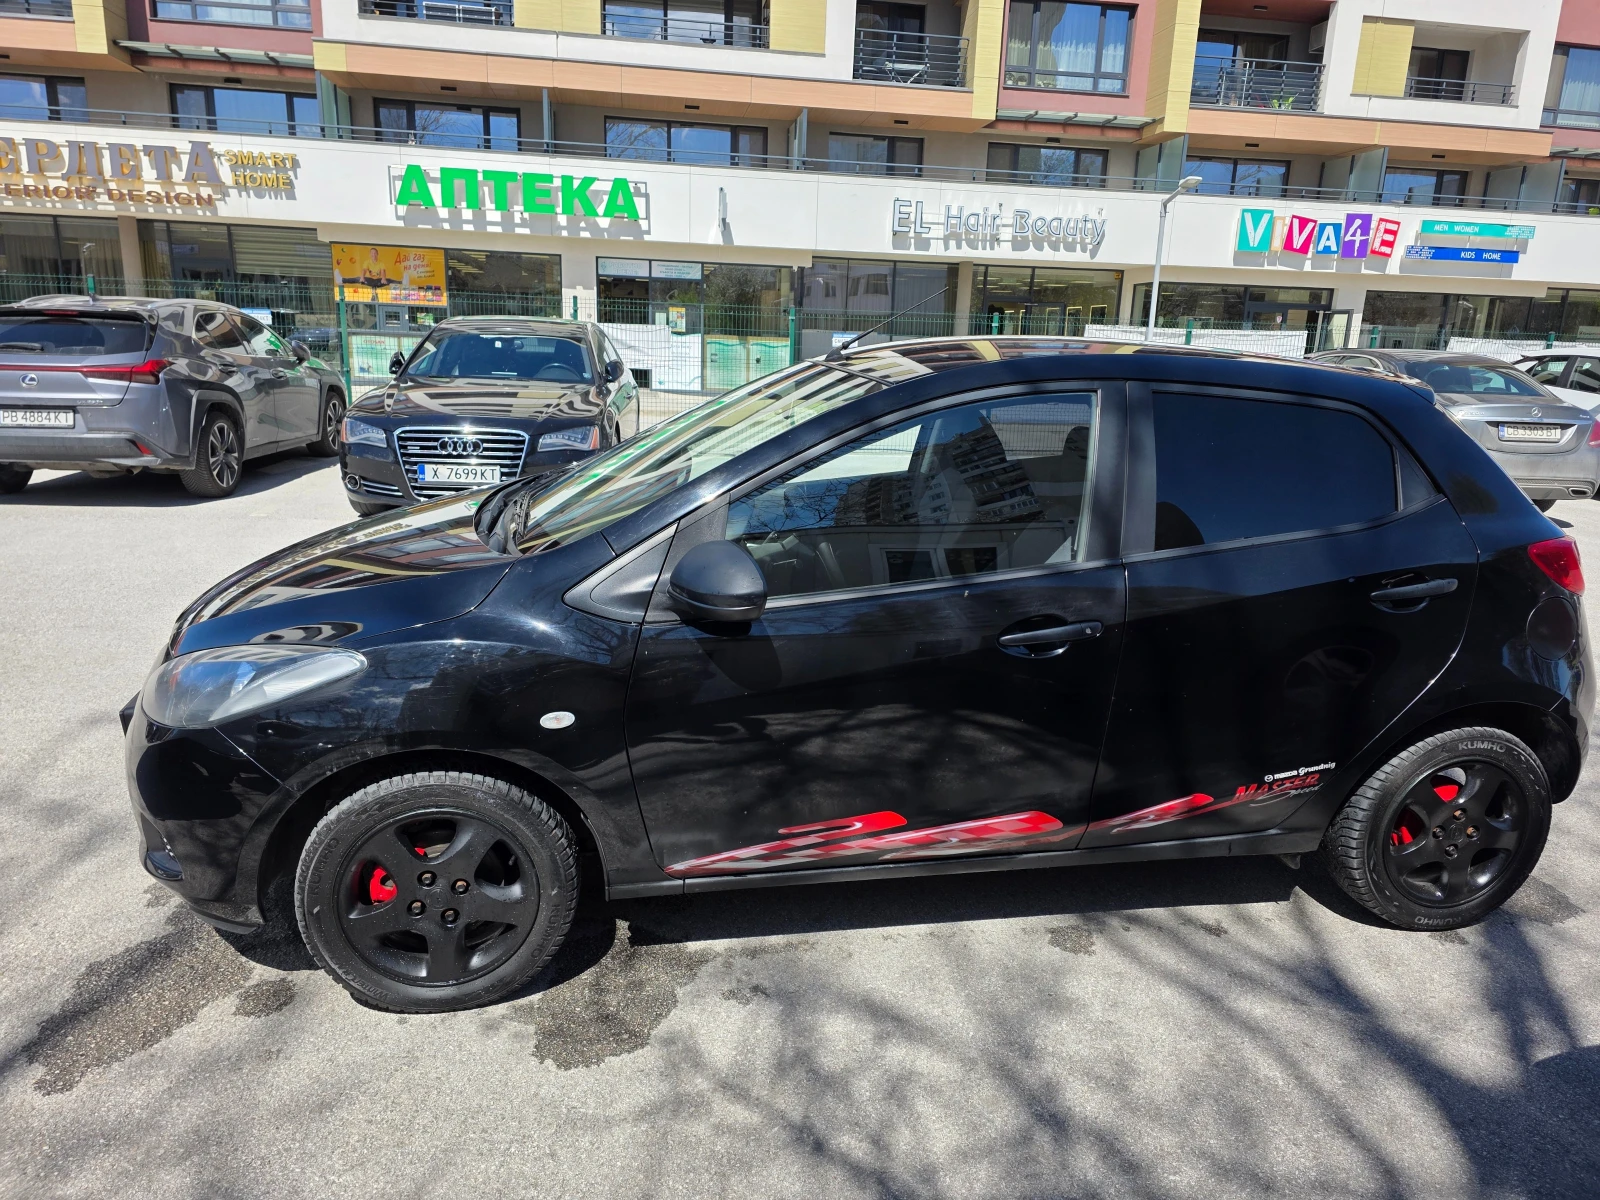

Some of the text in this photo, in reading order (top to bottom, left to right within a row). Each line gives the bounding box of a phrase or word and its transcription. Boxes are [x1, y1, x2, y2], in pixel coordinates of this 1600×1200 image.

[223, 149, 297, 168] SMART
[231, 171, 292, 189] HOME
[0, 184, 214, 207] ERIOR DESIGN
[396, 164, 640, 221] АПТЕКА
[893, 199, 1107, 244] EL Hair Beauty
[1433, 223, 1479, 233] MEN WOMEN
[1460, 251, 1501, 260] KIDS HOME
[21, 411, 51, 423] 4884
[54, 412, 71, 423] KT
[1519, 425, 1545, 437] 3303
[1546, 426, 1559, 437] BT
[432, 467, 497, 480] X 7699 KT
[1458, 740, 1507, 753] KUMHO
